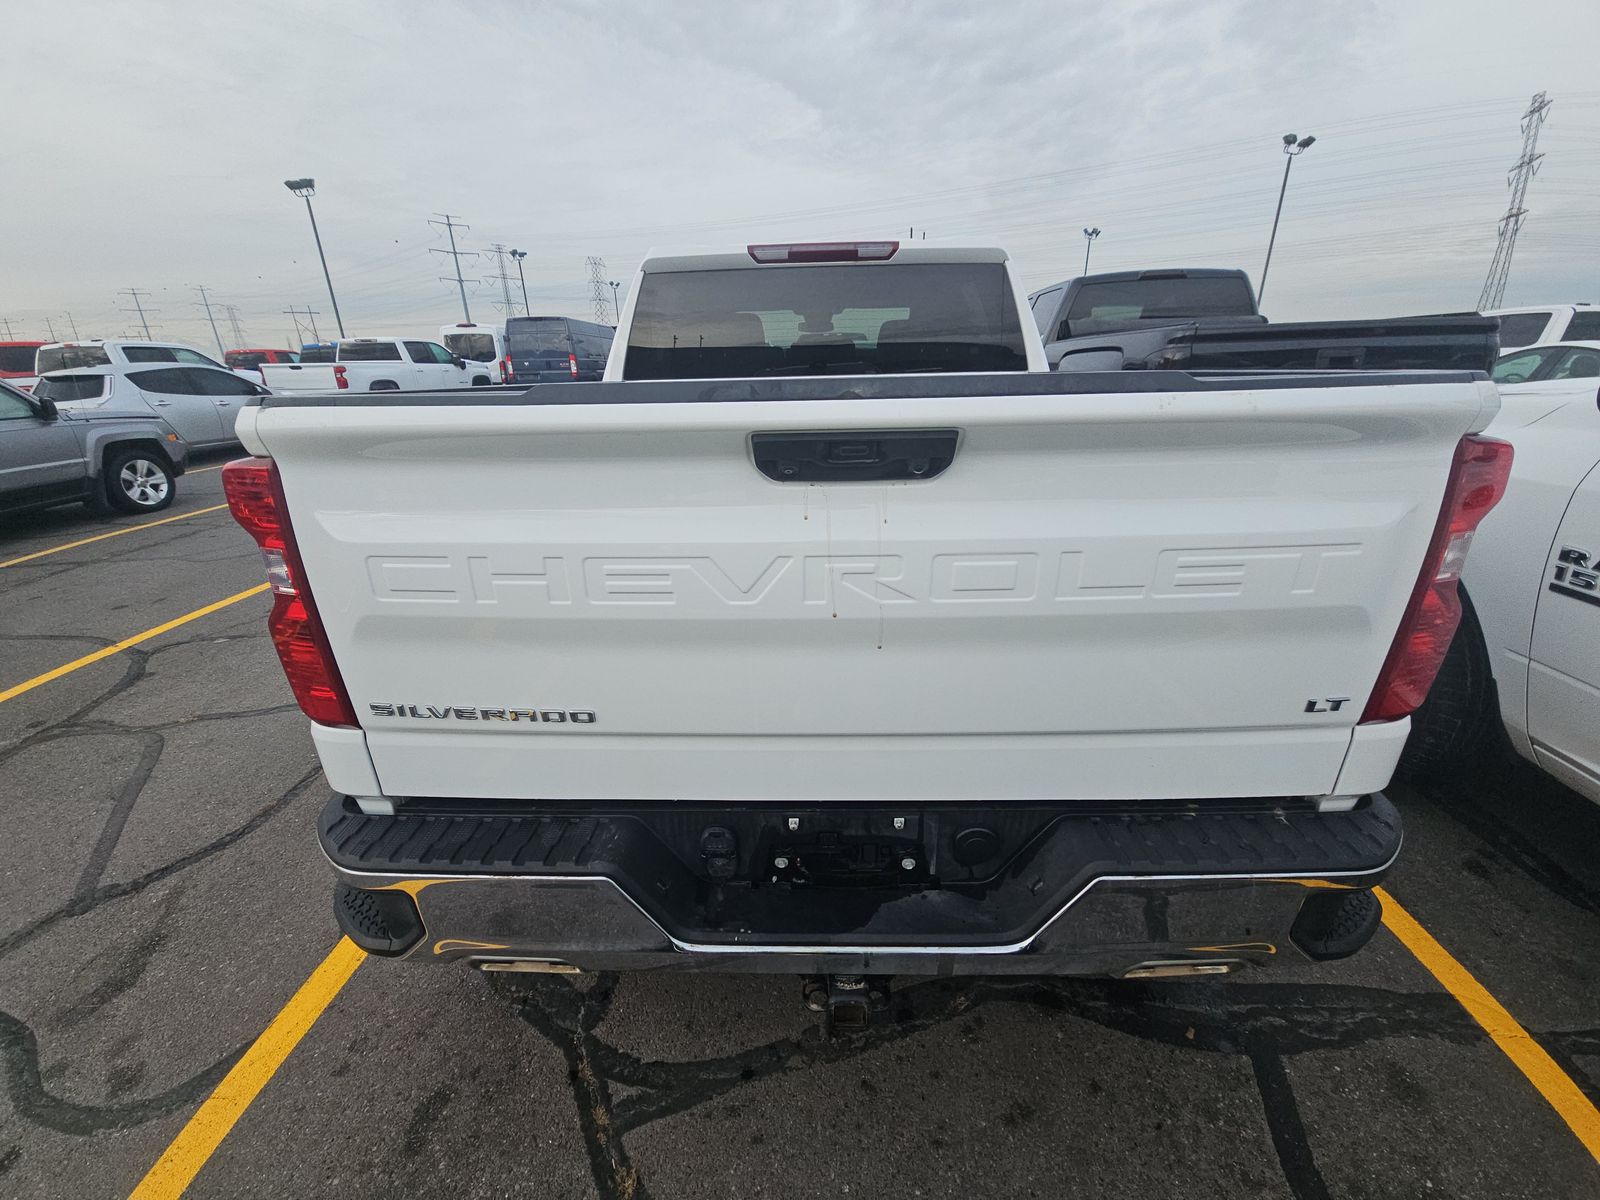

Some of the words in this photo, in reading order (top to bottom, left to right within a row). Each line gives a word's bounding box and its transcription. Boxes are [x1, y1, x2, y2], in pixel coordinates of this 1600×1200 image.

[365, 542, 1364, 606] CHEVROLET
[369, 701, 597, 724] SILVERADO
[1304, 697, 1351, 713] LT
